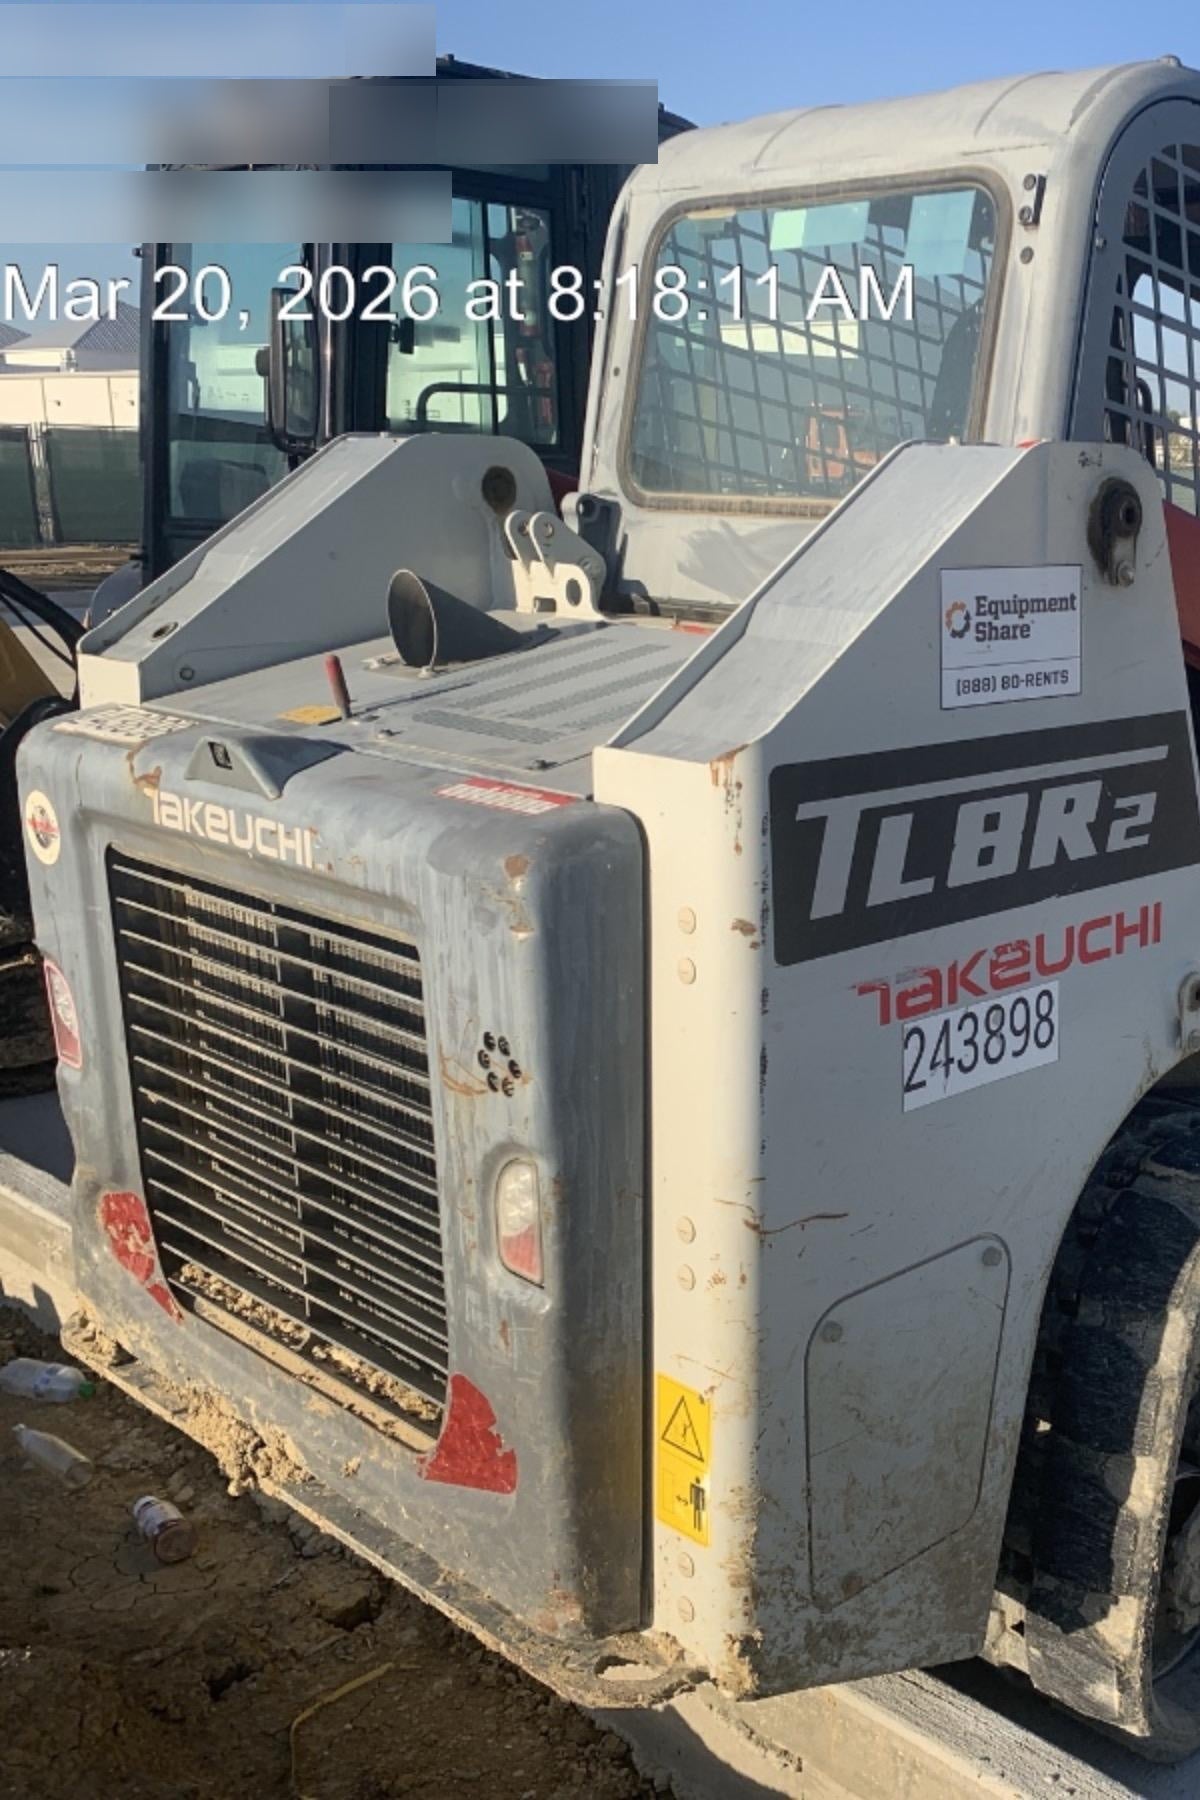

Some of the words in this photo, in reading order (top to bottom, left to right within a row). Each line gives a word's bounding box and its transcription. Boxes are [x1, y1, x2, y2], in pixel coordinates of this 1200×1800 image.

[974, 592, 1077, 621] Equipment
[974, 621, 1031, 643] Share
[956, 675, 997, 697] (888)
[903, 988, 1056, 1094] 243898
